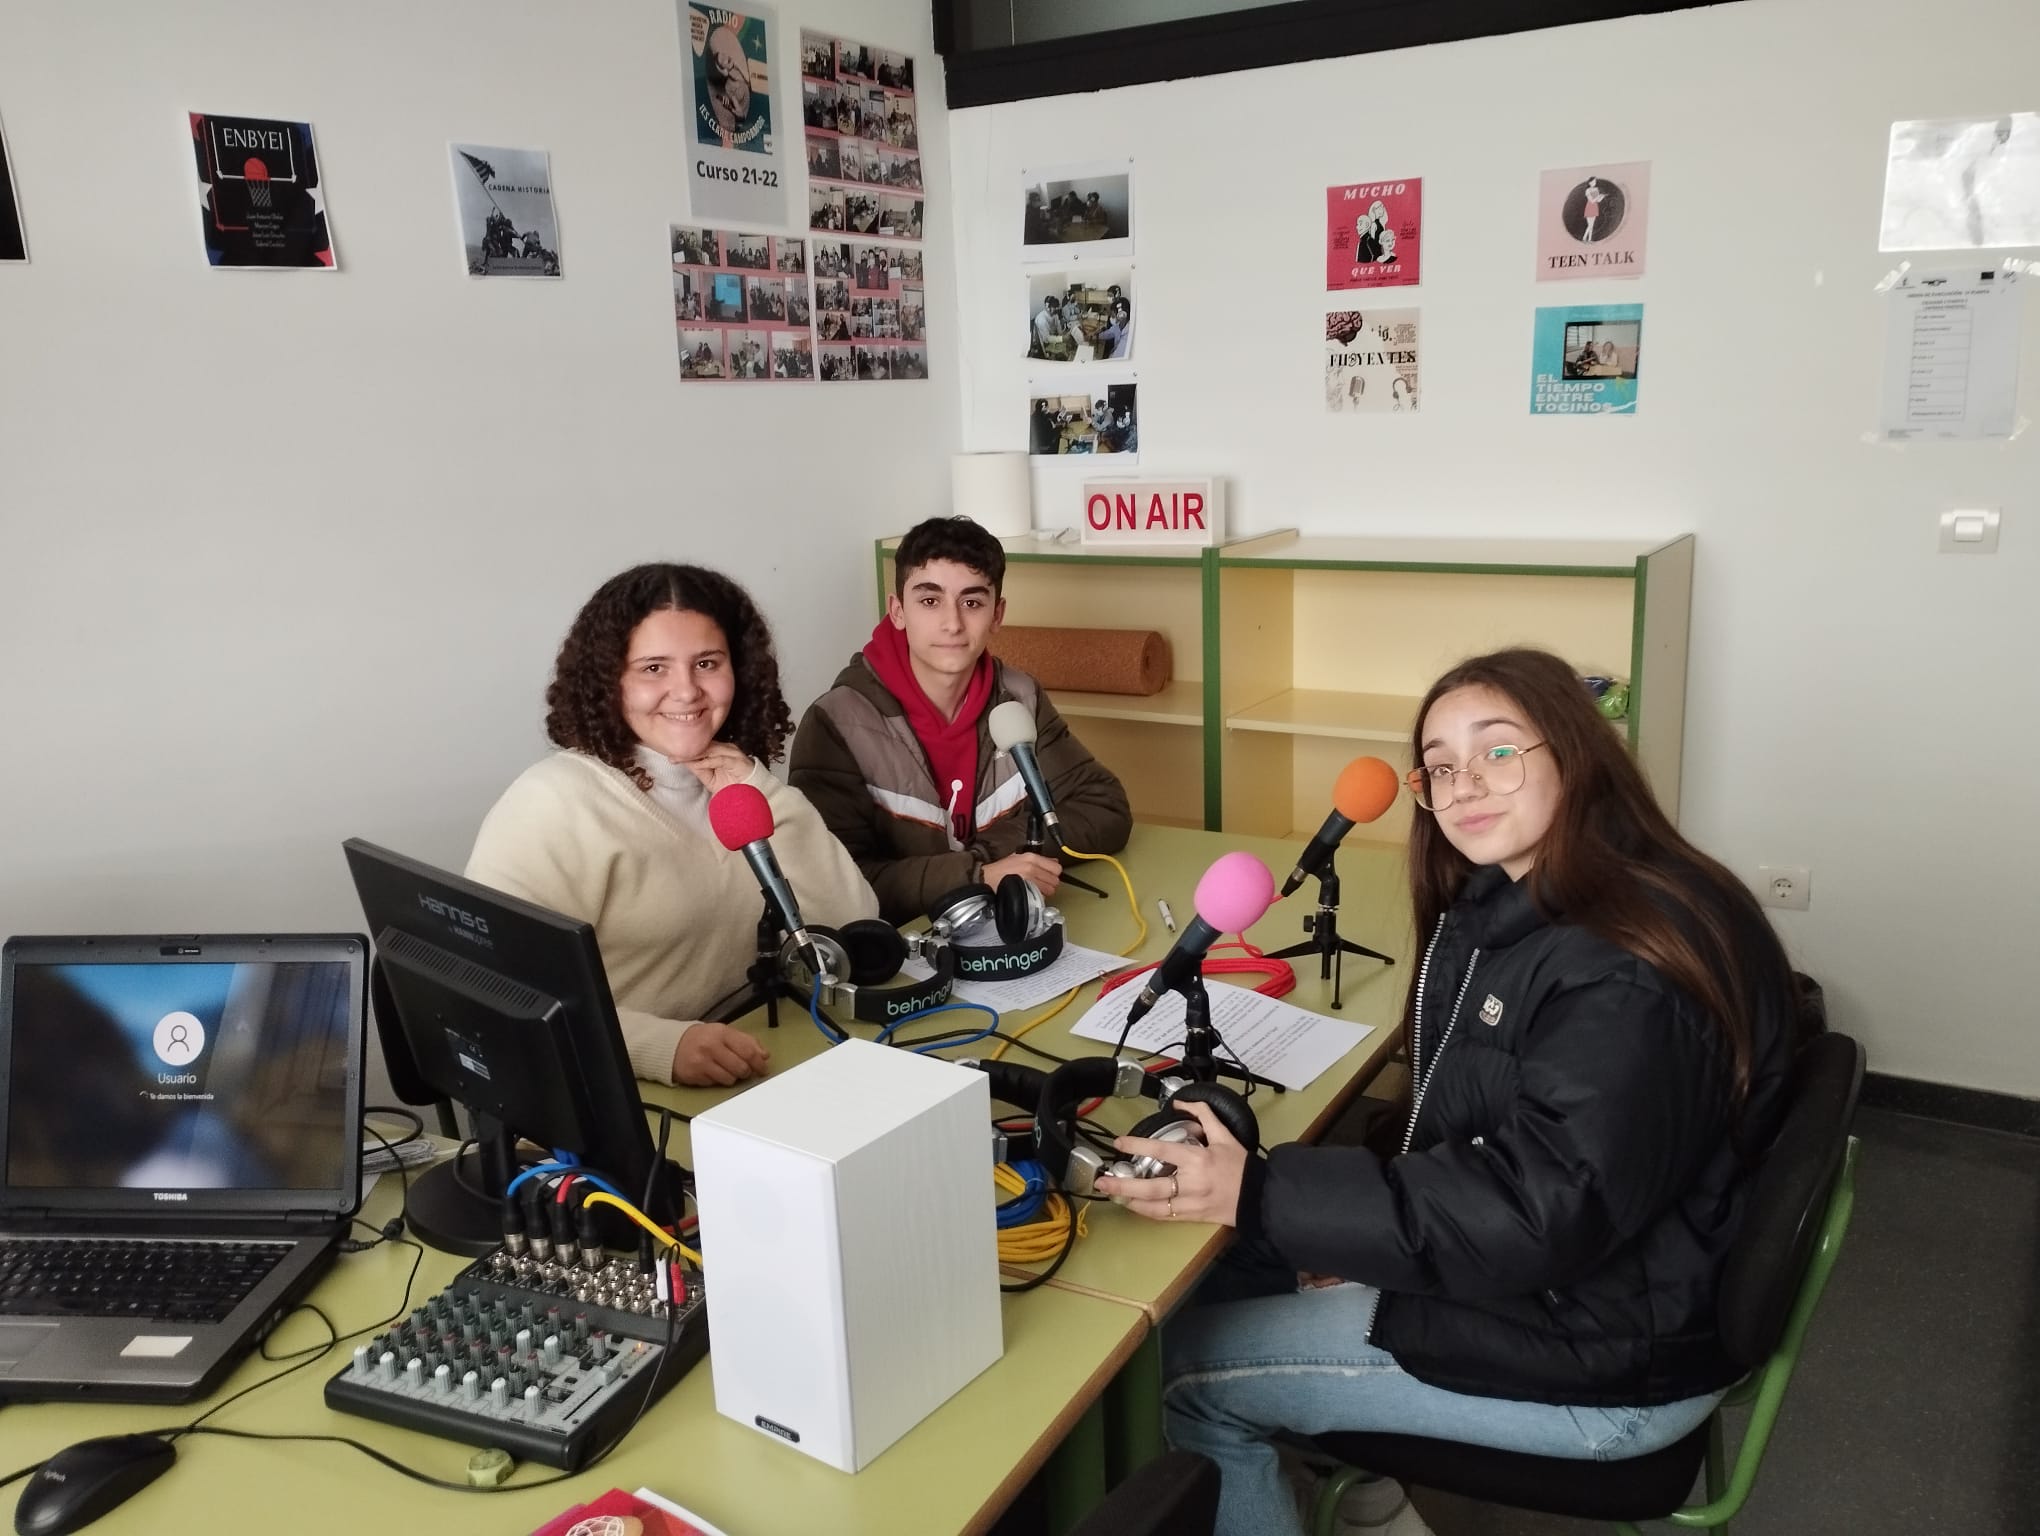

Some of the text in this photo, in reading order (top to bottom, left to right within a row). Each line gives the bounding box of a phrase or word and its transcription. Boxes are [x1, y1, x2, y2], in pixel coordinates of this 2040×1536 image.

[708, 9, 738, 28] RADIO
[699, 104, 710, 121] IES
[222, 127, 284, 151] ENBYEI
[696, 160, 778, 188] Curso 21-22
[488, 183, 516, 193] CADENA
[1343, 183, 1406, 201] MUCHO
[1548, 250, 1635, 269] TEEN TALK
[1351, 264, 1402, 277] QUE VER
[1536, 374, 1558, 383] EL
[1535, 383, 1605, 393] TIEMPO
[1535, 392, 1595, 403] ENTRE
[1535, 402, 1613, 413] TOCINOS
[1087, 492, 1206, 531] ON AIR
[960, 945, 1048, 972] behringer
[157, 1072, 197, 1085] Usuario
[153, 1192, 188, 1201] TOSHIBA
